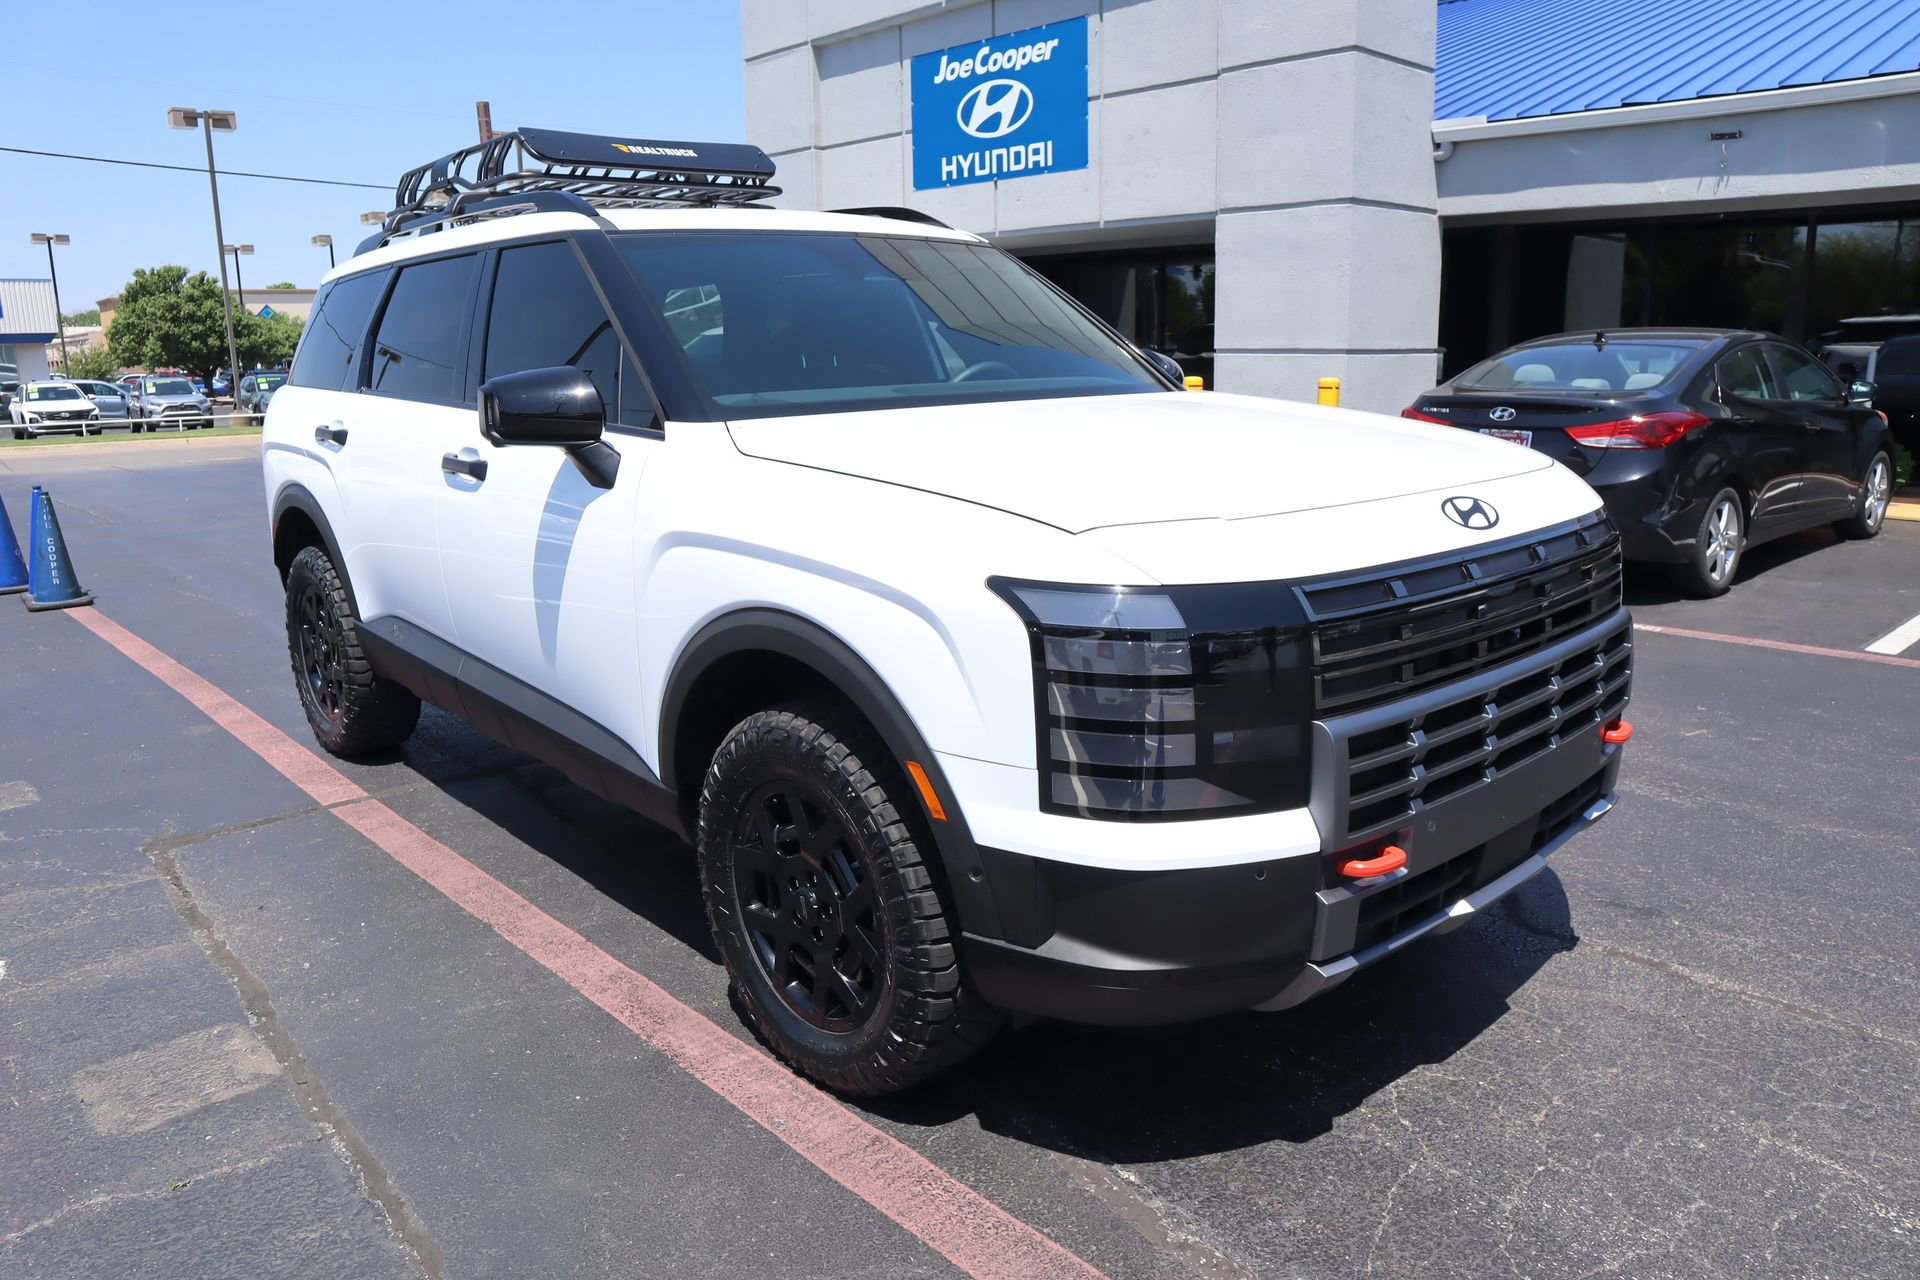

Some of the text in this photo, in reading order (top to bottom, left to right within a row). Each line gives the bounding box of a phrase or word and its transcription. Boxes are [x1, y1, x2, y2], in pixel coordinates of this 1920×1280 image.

[627, 145, 699, 158] REALTRUCK
[941, 140, 1053, 181] HYUNDAI
[47, 537, 60, 585] COOPER
